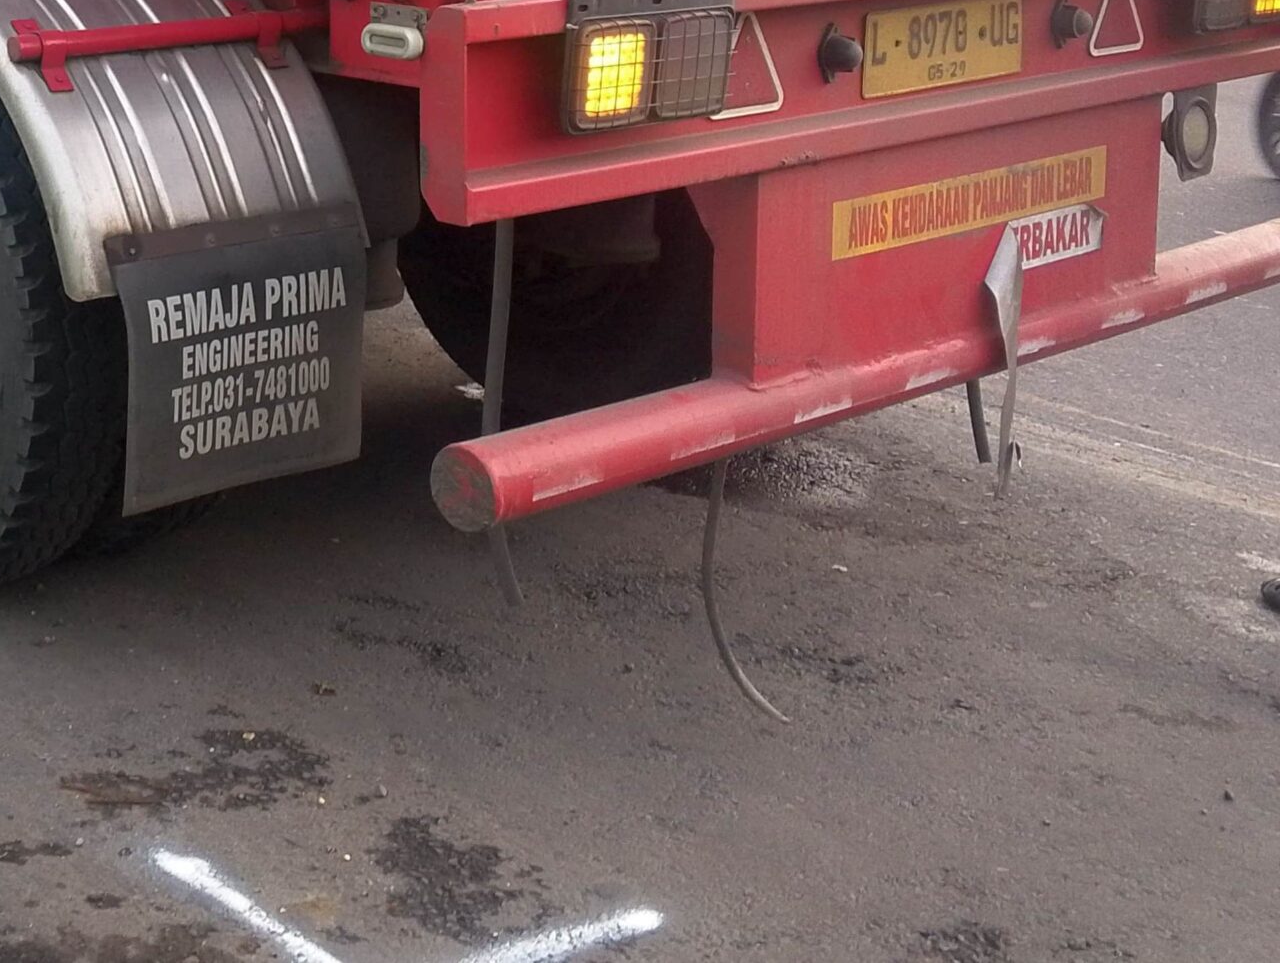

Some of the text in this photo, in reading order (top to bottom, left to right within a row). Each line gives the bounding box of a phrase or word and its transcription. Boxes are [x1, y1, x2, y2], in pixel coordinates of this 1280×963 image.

[872, 21, 888, 66] L
[990, 1, 1020, 47] UG
[848, 156, 1092, 250] AWAS KENDARAAN PANJANG DAN LEBAR
[1012, 209, 1090, 262] RBAKAR
[147, 266, 346, 344] REMAJA PRIMA
[182, 320, 319, 380] ENGINEERING
[171, 356, 330, 424] TELP.031-7481000
[179, 398, 320, 460] SURABAYA
